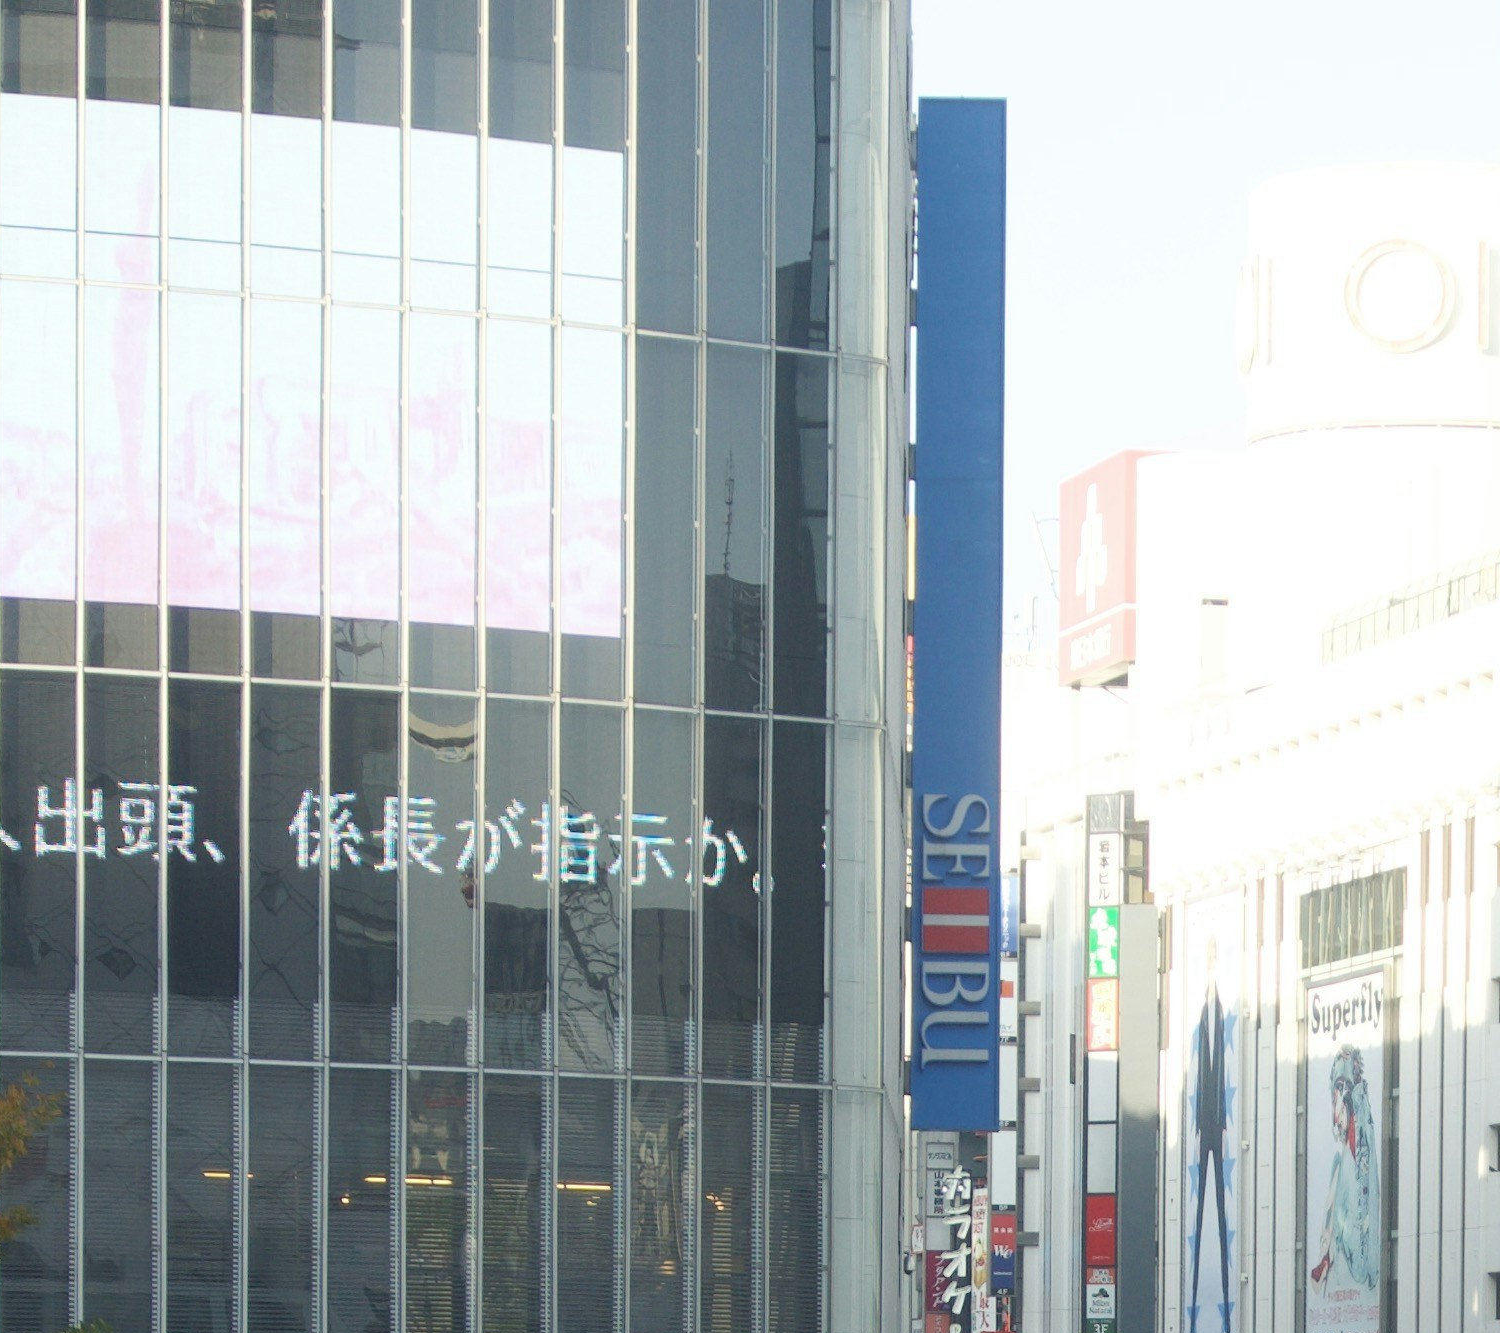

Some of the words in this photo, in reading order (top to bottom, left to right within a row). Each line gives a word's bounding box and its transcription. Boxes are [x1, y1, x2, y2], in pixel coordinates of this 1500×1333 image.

[289, 789, 776, 896] 係長が指示か。
[1310, 981, 1385, 1042] Superfly
